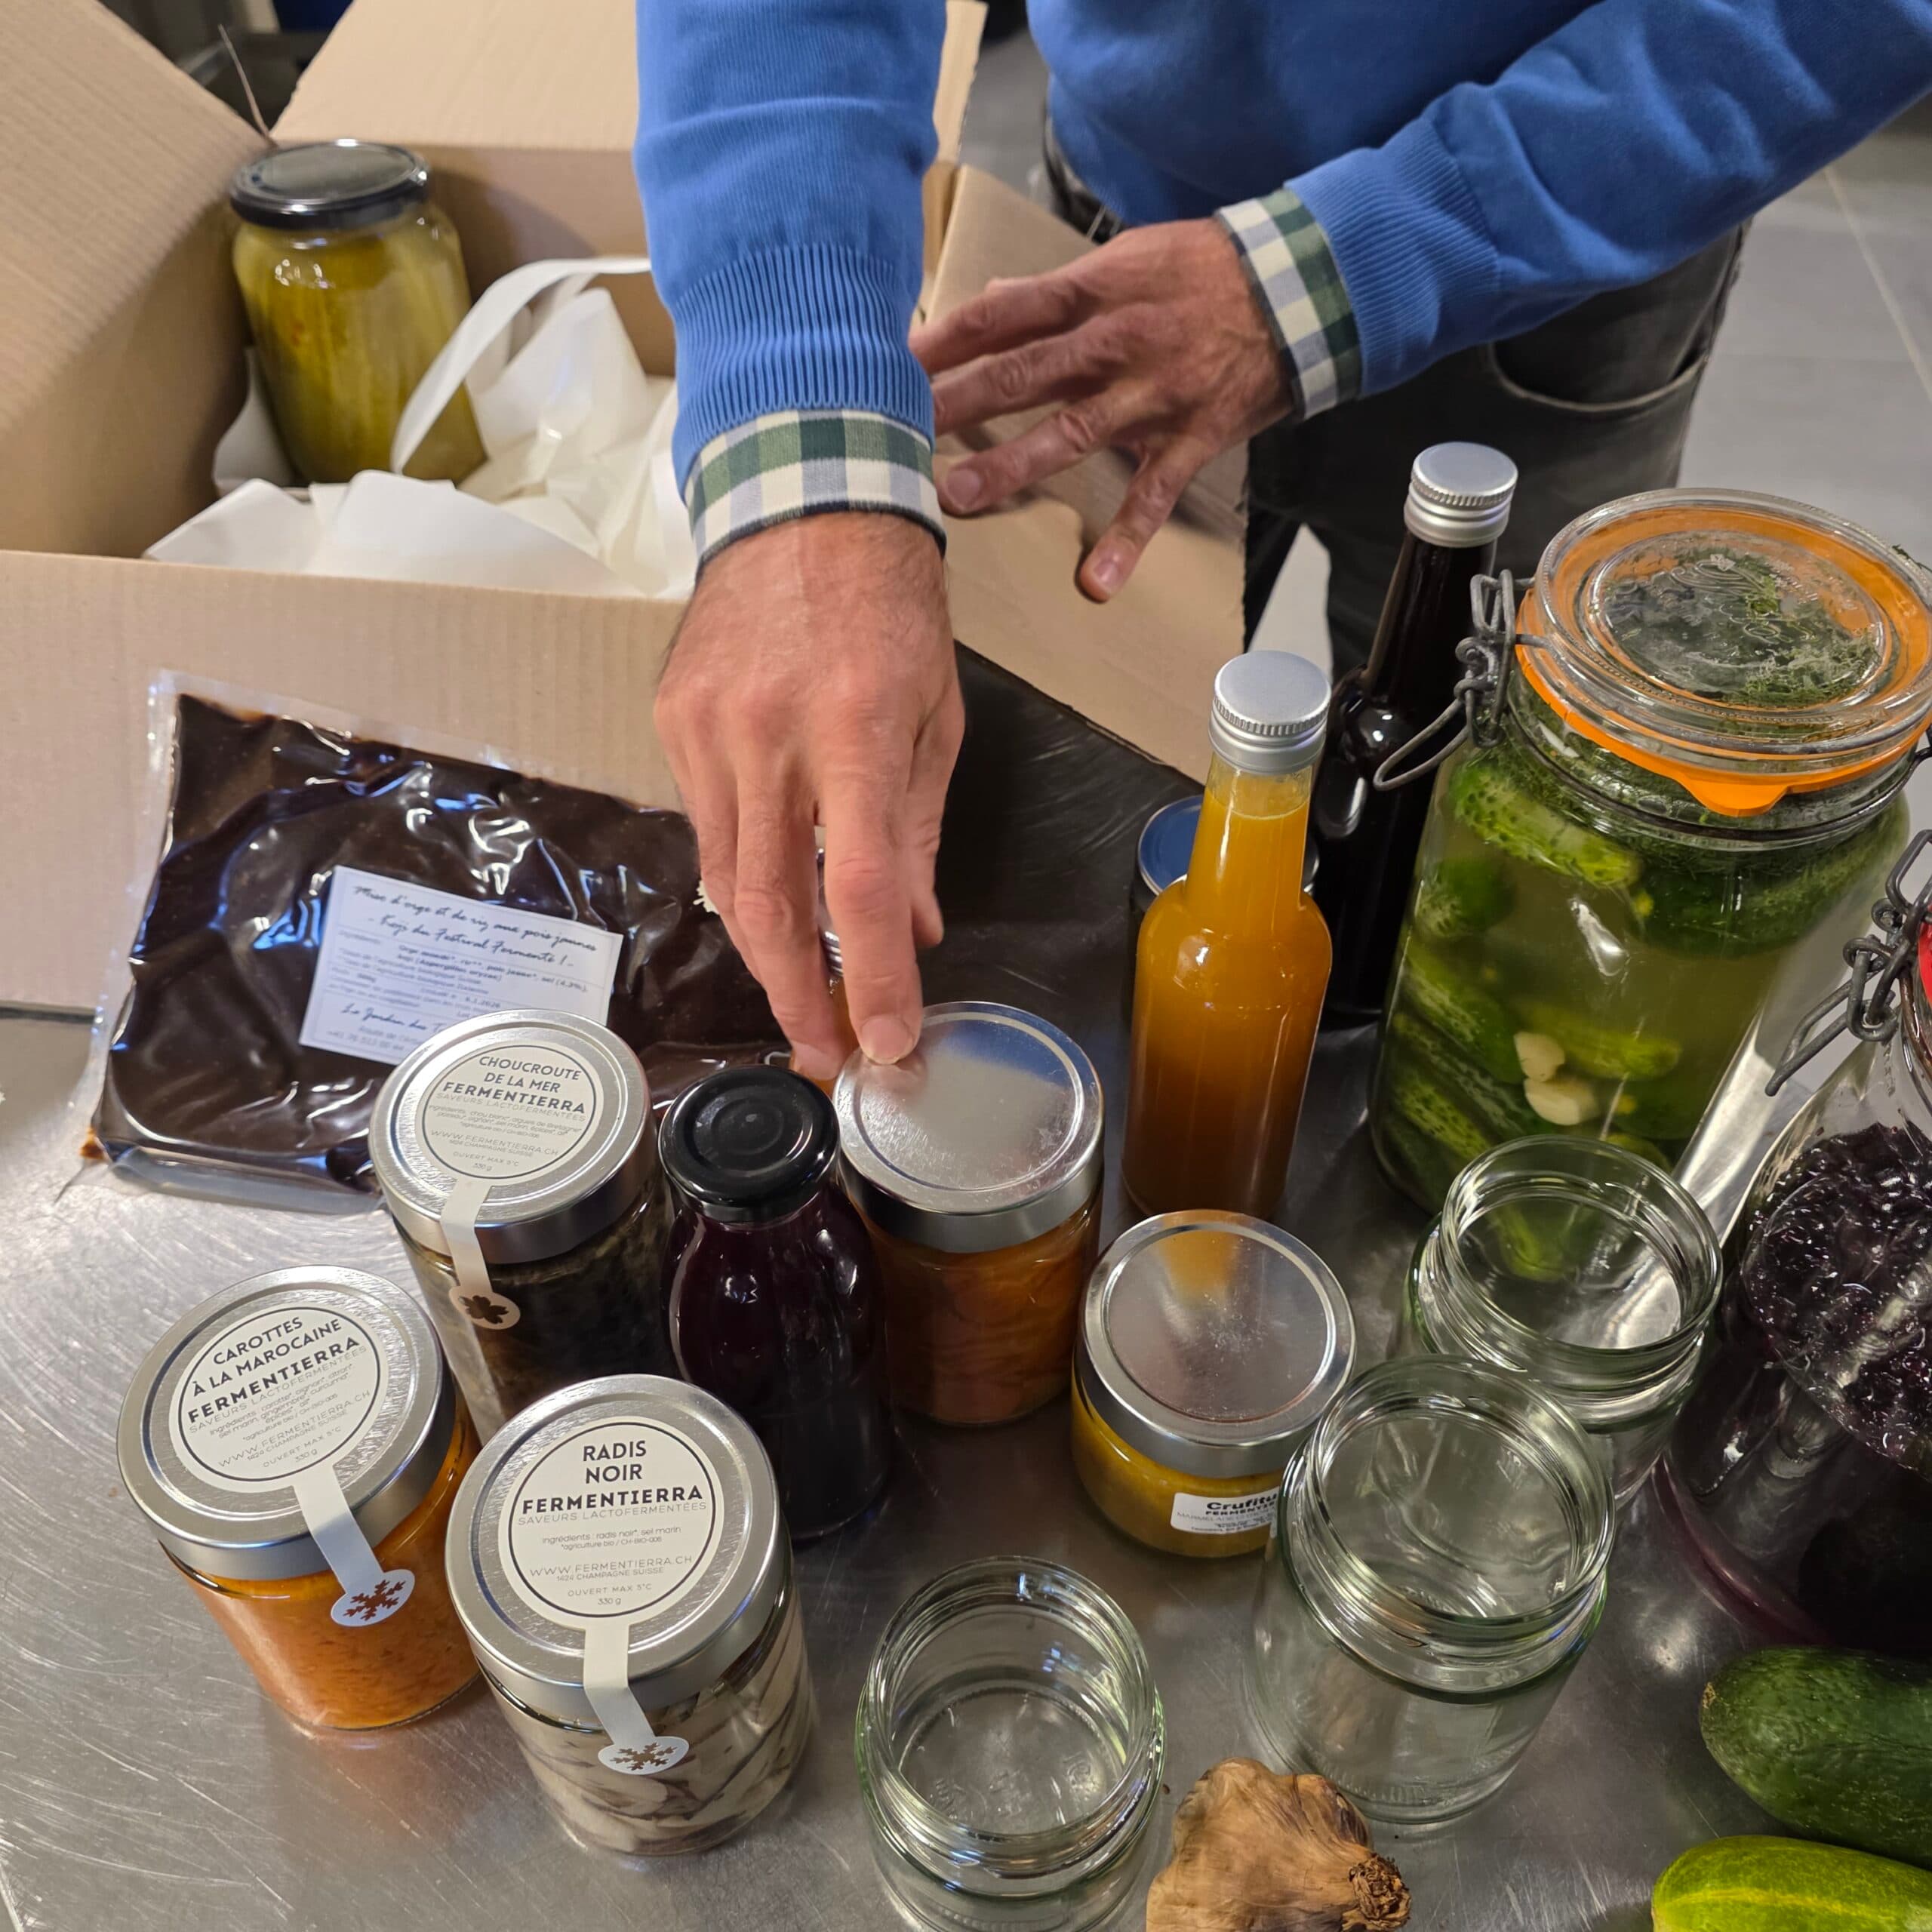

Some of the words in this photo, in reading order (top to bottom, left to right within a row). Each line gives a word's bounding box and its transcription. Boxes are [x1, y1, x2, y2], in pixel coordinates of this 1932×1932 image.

[380, 915, 408, 936] Koji
[435, 928, 489, 949] Festival
[491, 941, 555, 963] Fermenté
[435, 907, 451, 915] et
[452, 910, 466, 921] de
[521, 930, 551, 940] pois
[551, 933, 597, 951] jaunes
[479, 1056, 581, 1081] CHOUCROUTE
[484, 1072, 503, 1084] DE
[507, 1075, 524, 1088] LA
[529, 1079, 561, 1093] MER
[435, 1093, 483, 1104] SAVEURS
[443, 1082, 585, 1114] FERMENTIERRA
[213, 1317, 303, 1365] CAROTTES
[192, 1380, 206, 1397] À
[209, 1370, 233, 1389] LA
[235, 1318, 342, 1377] MAROCAINE
[187, 1337, 360, 1423] FERMENTIERRA
[189, 1403, 247, 1433] SAVEURS
[263, 1445, 300, 1467] OUVERT
[304, 1435, 324, 1447] MAX
[583, 1440, 647, 1461] RADIS
[586, 1463, 642, 1484] NOIR
[522, 1484, 703, 1514] FERMENTIERRA
[518, 1512, 577, 1525] SAVEURS
[583, 1502, 706, 1519] LACTOFERMENTÉES
[530, 1555, 692, 1577] WWW.FERMENTIERRA.CH
[576, 1570, 630, 1581] CHAMPAGNE
[633, 1567, 663, 1575] SUISSE
[568, 1587, 608, 1597] OUVERT
[612, 1585, 633, 1593] MAX
[615, 1598, 621, 1606] g
